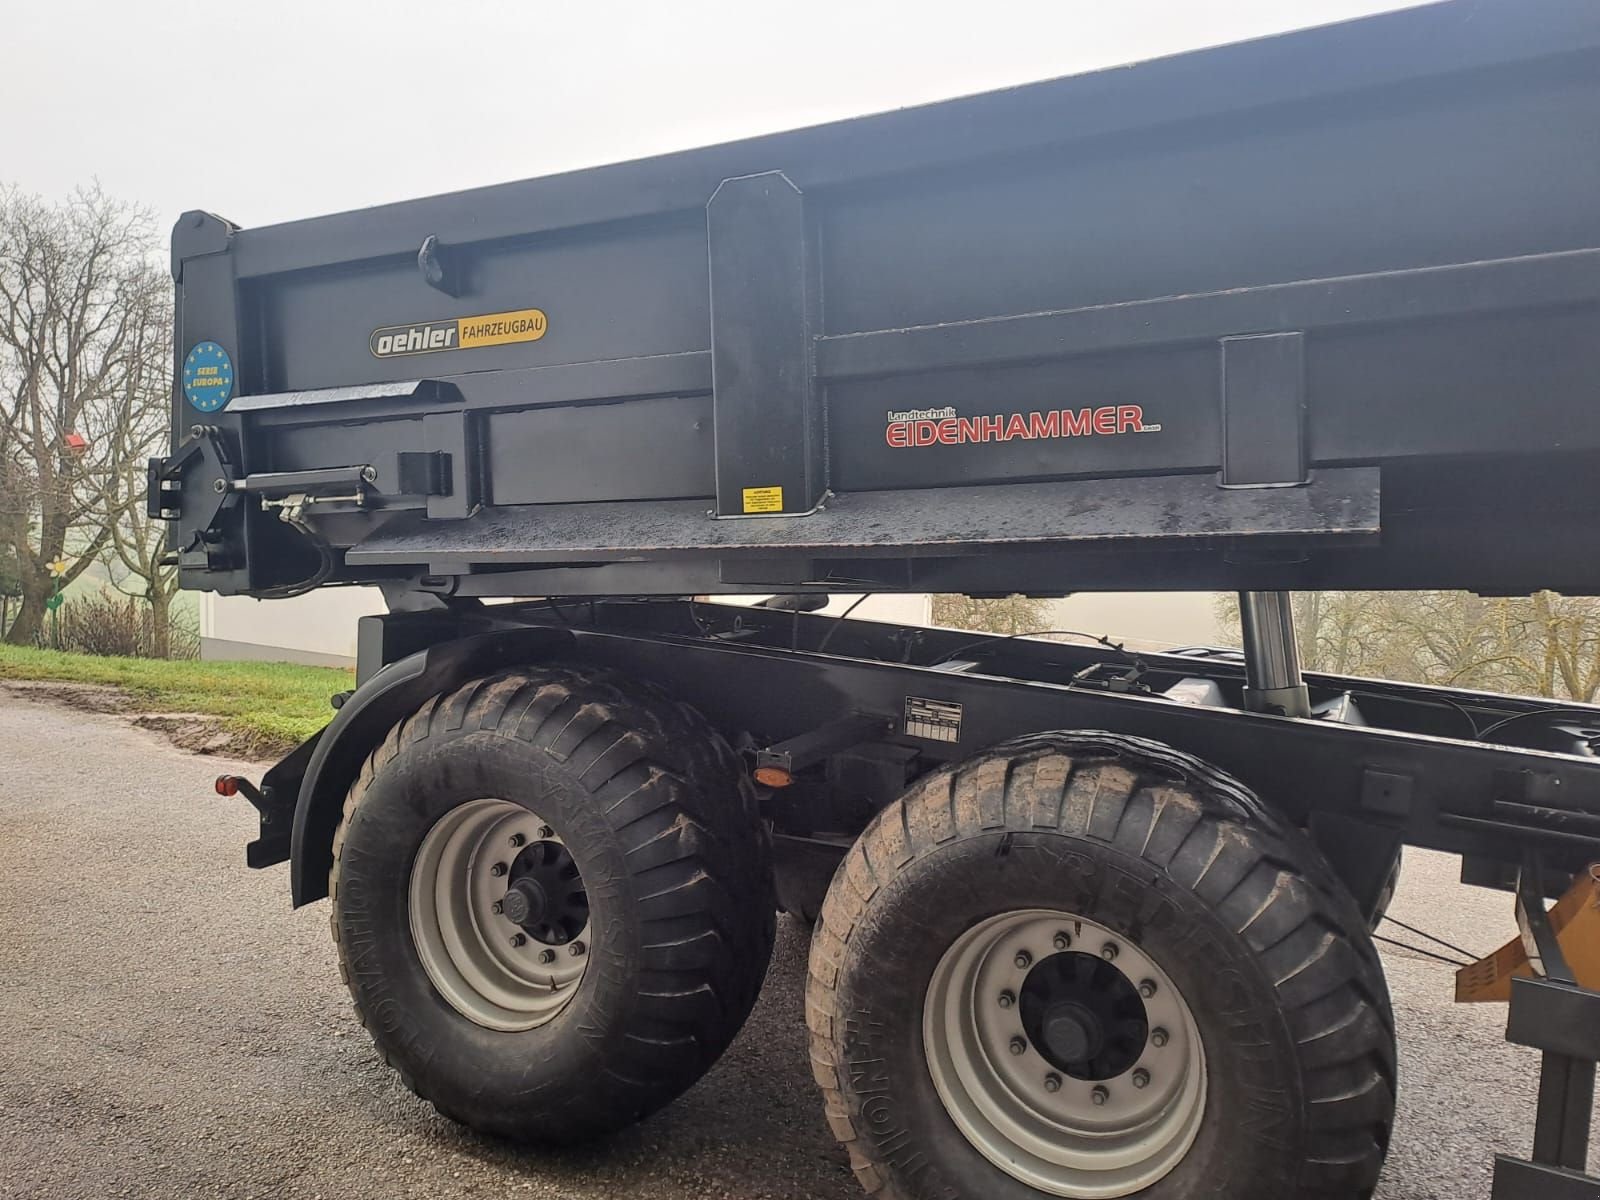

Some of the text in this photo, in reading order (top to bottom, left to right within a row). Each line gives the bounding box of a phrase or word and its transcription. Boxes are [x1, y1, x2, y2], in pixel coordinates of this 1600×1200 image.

[377, 317, 543, 354] oehler FAHRZEUGBAU
[886, 405, 1143, 448] EIDENHAMMER
[887, 406, 957, 422] Landtechnik
